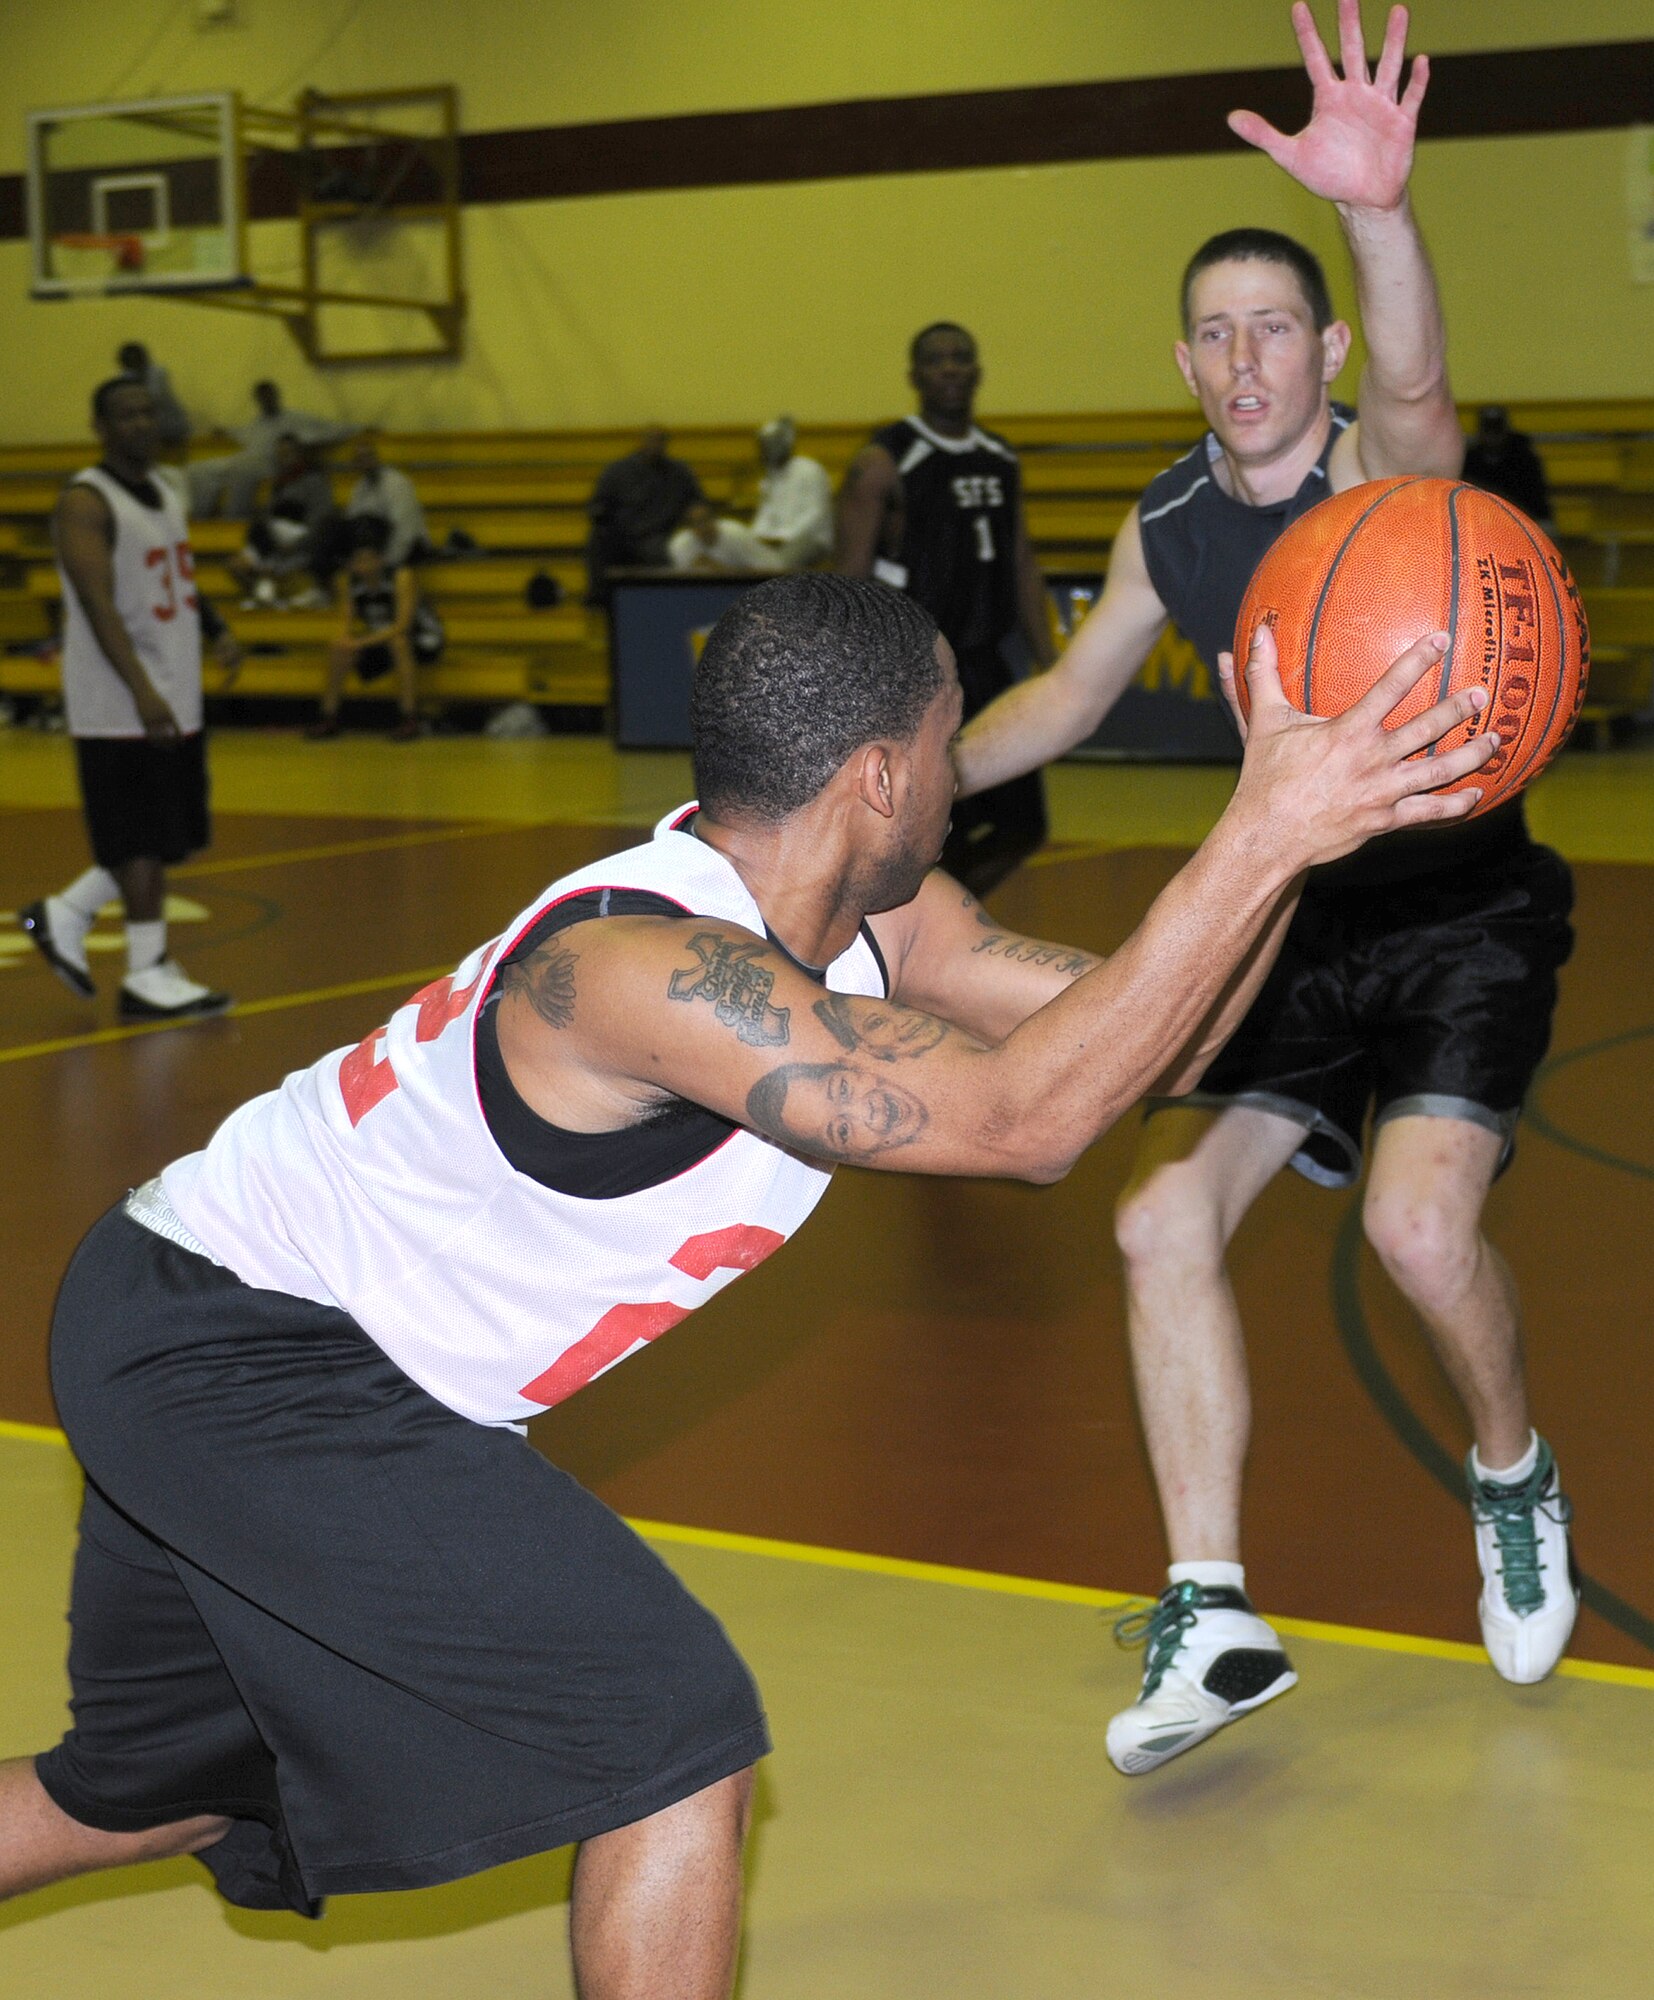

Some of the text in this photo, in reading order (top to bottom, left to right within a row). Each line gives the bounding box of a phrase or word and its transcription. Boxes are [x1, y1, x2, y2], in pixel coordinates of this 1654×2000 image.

[975, 516, 995, 561] 1
[1477, 558, 1497, 685] ZK Microfiber
[1479, 559, 1535, 776] TF-1000
